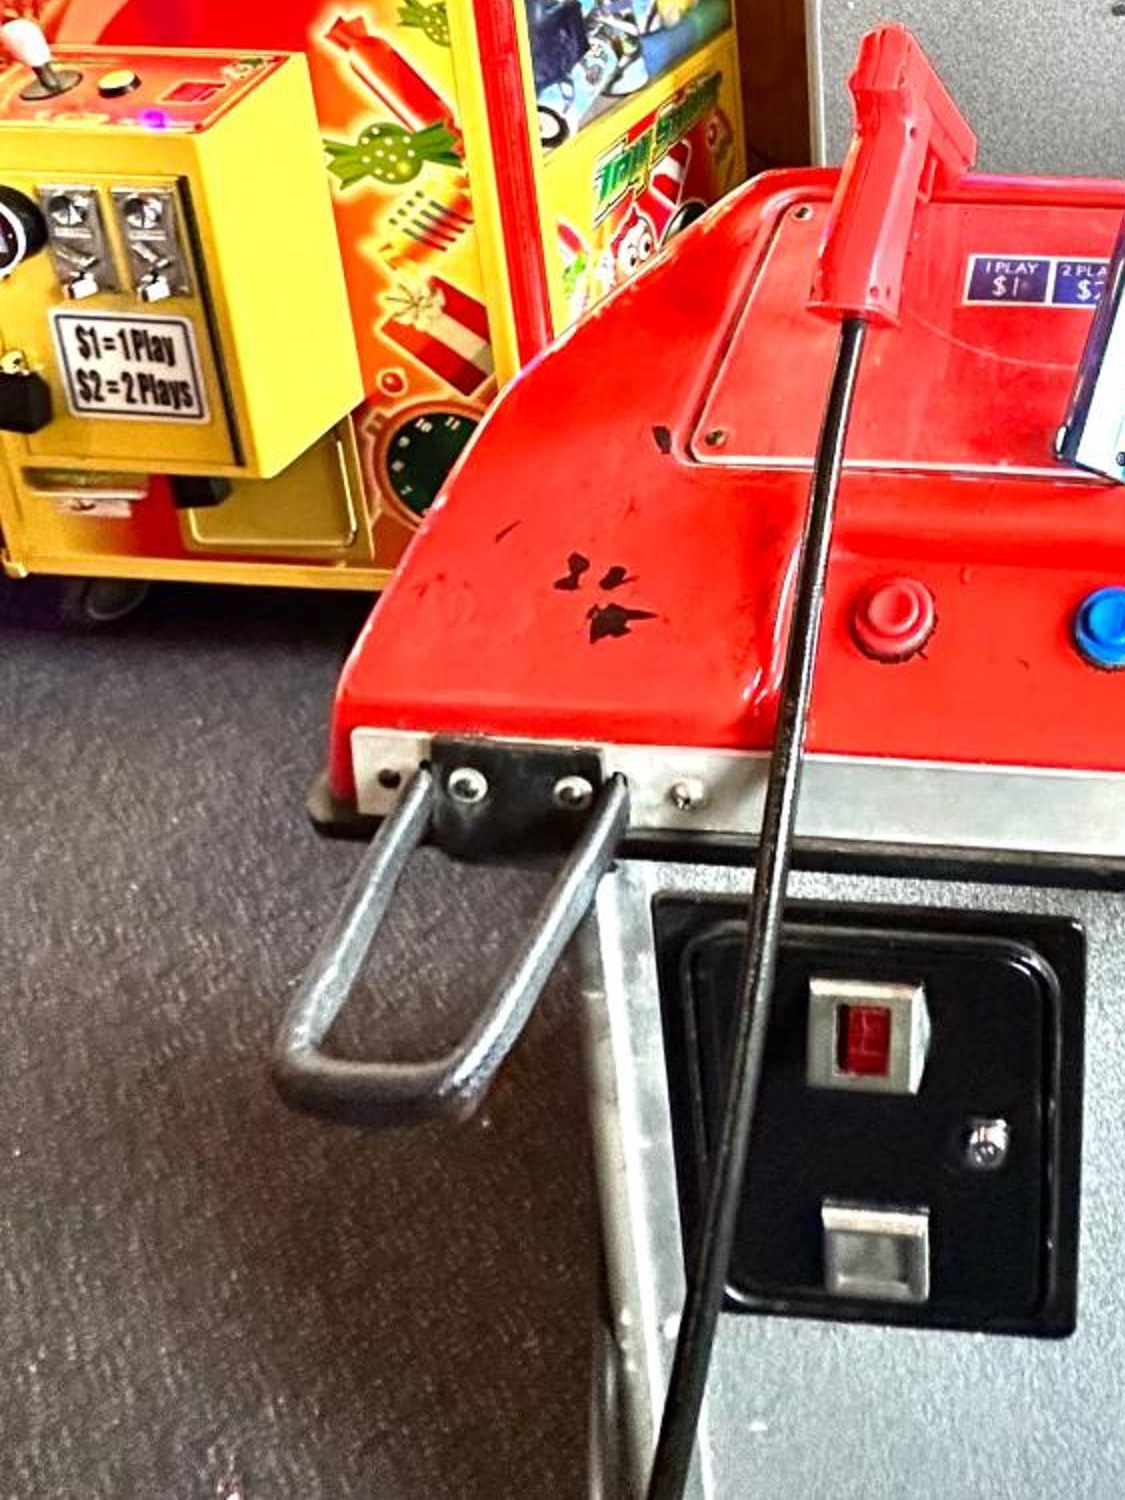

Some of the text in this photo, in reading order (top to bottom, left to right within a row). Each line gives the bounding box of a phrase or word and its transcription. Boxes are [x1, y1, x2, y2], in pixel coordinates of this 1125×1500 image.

[985, 261, 1039, 275] 1 PLAY
[1061, 265, 1108, 277] 2 PLA
[992, 275, 1020, 298] $1
[130, 328, 176, 368] Play
[136, 372, 194, 410] Plays
